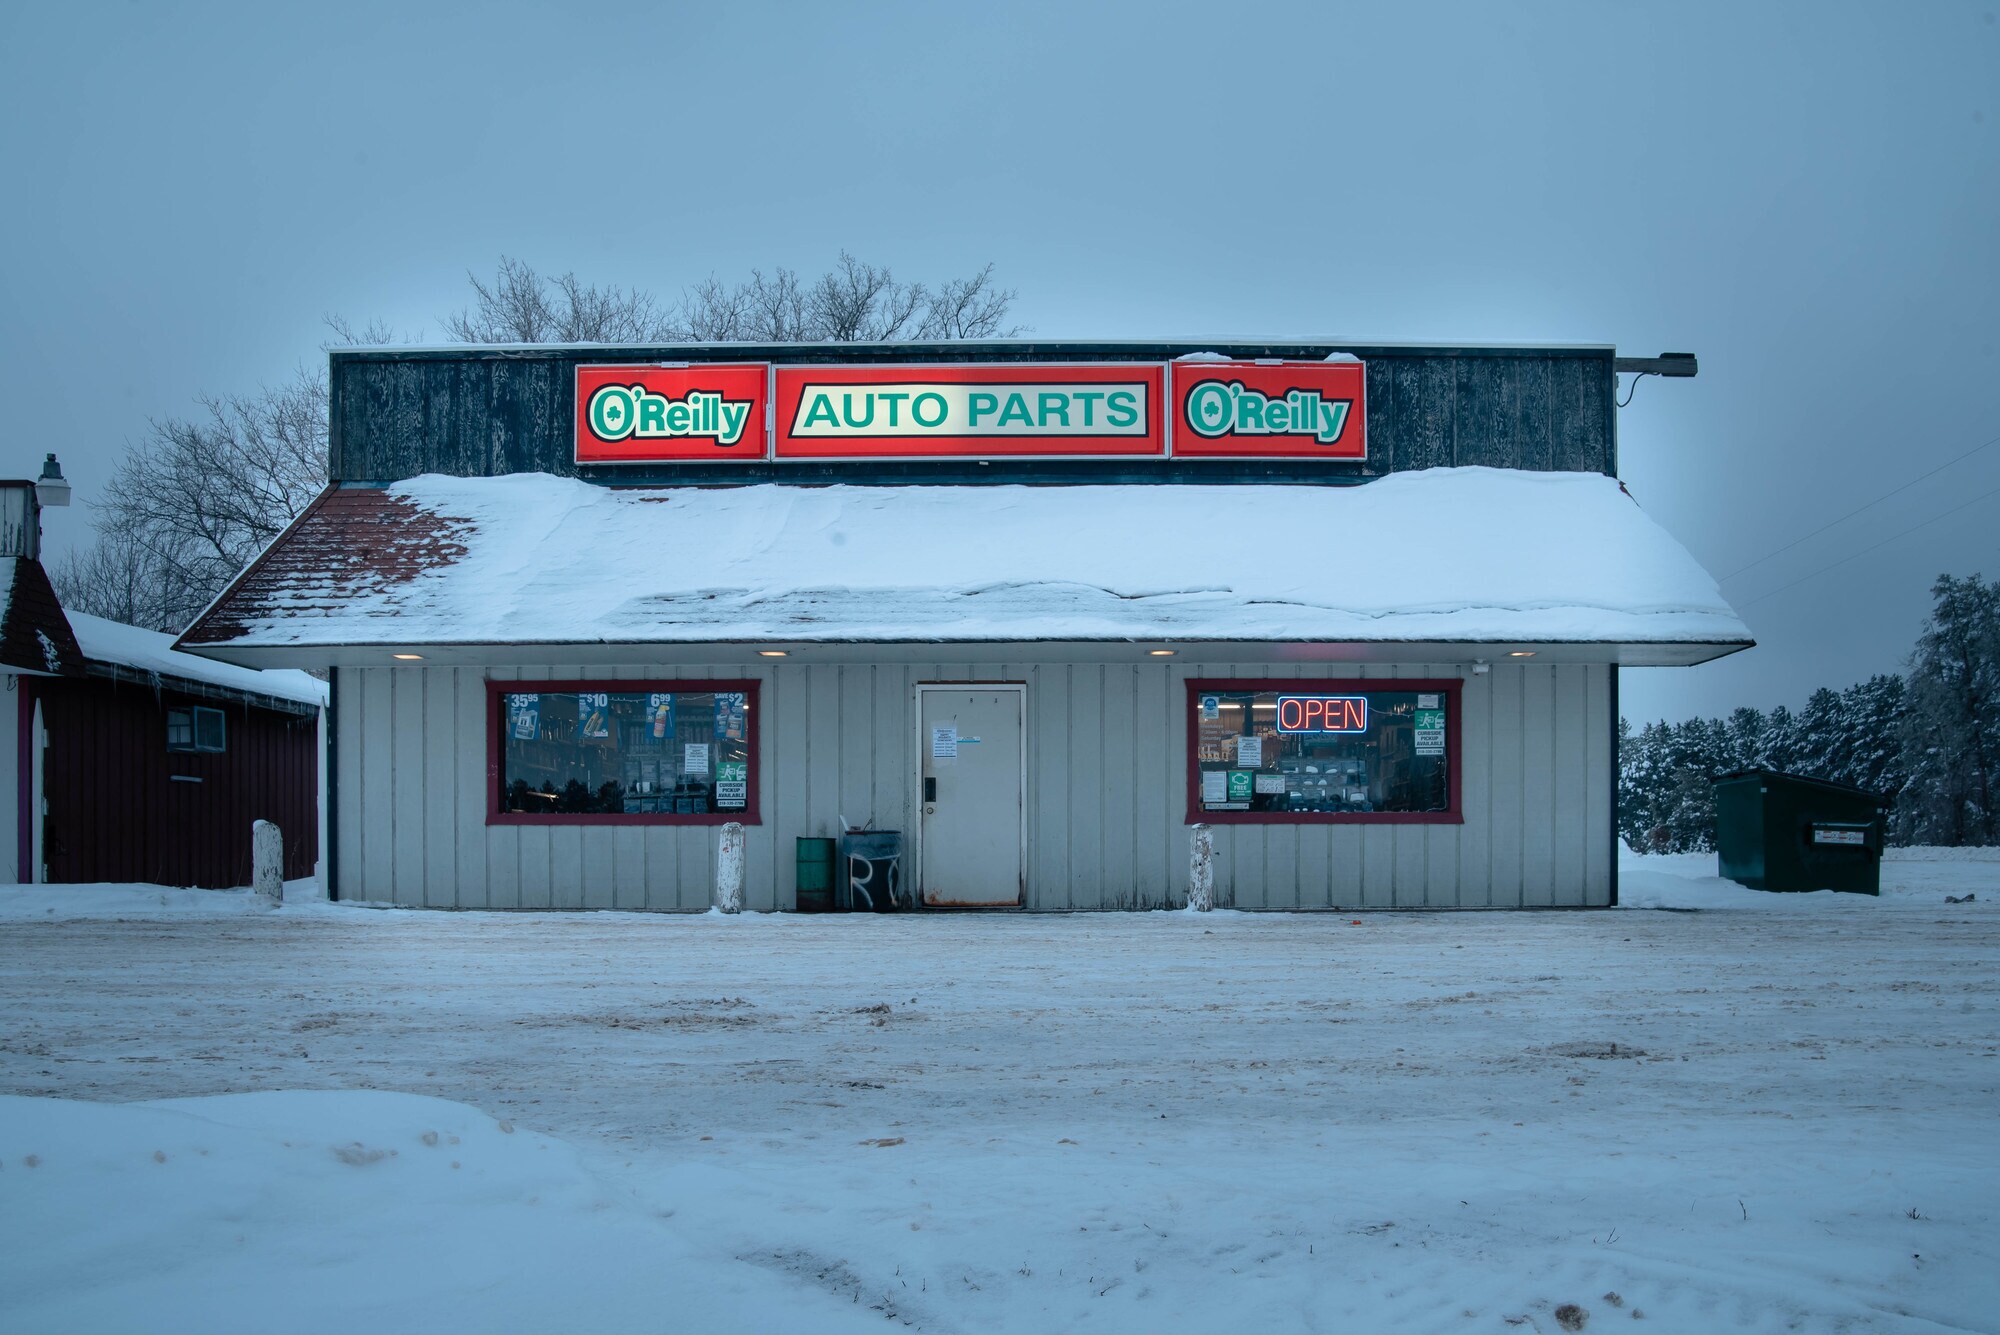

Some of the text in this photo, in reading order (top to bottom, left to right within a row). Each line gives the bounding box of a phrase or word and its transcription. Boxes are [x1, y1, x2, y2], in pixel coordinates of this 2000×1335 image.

[594, 385, 749, 441] O'Reilly
[806, 390, 1140, 427] AUTO PARTS
[1188, 383, 1345, 440] O'Reilly
[586, 693, 608, 707] $10
[728, 693, 744, 706] $2
[1280, 699, 1365, 729] OPEN
